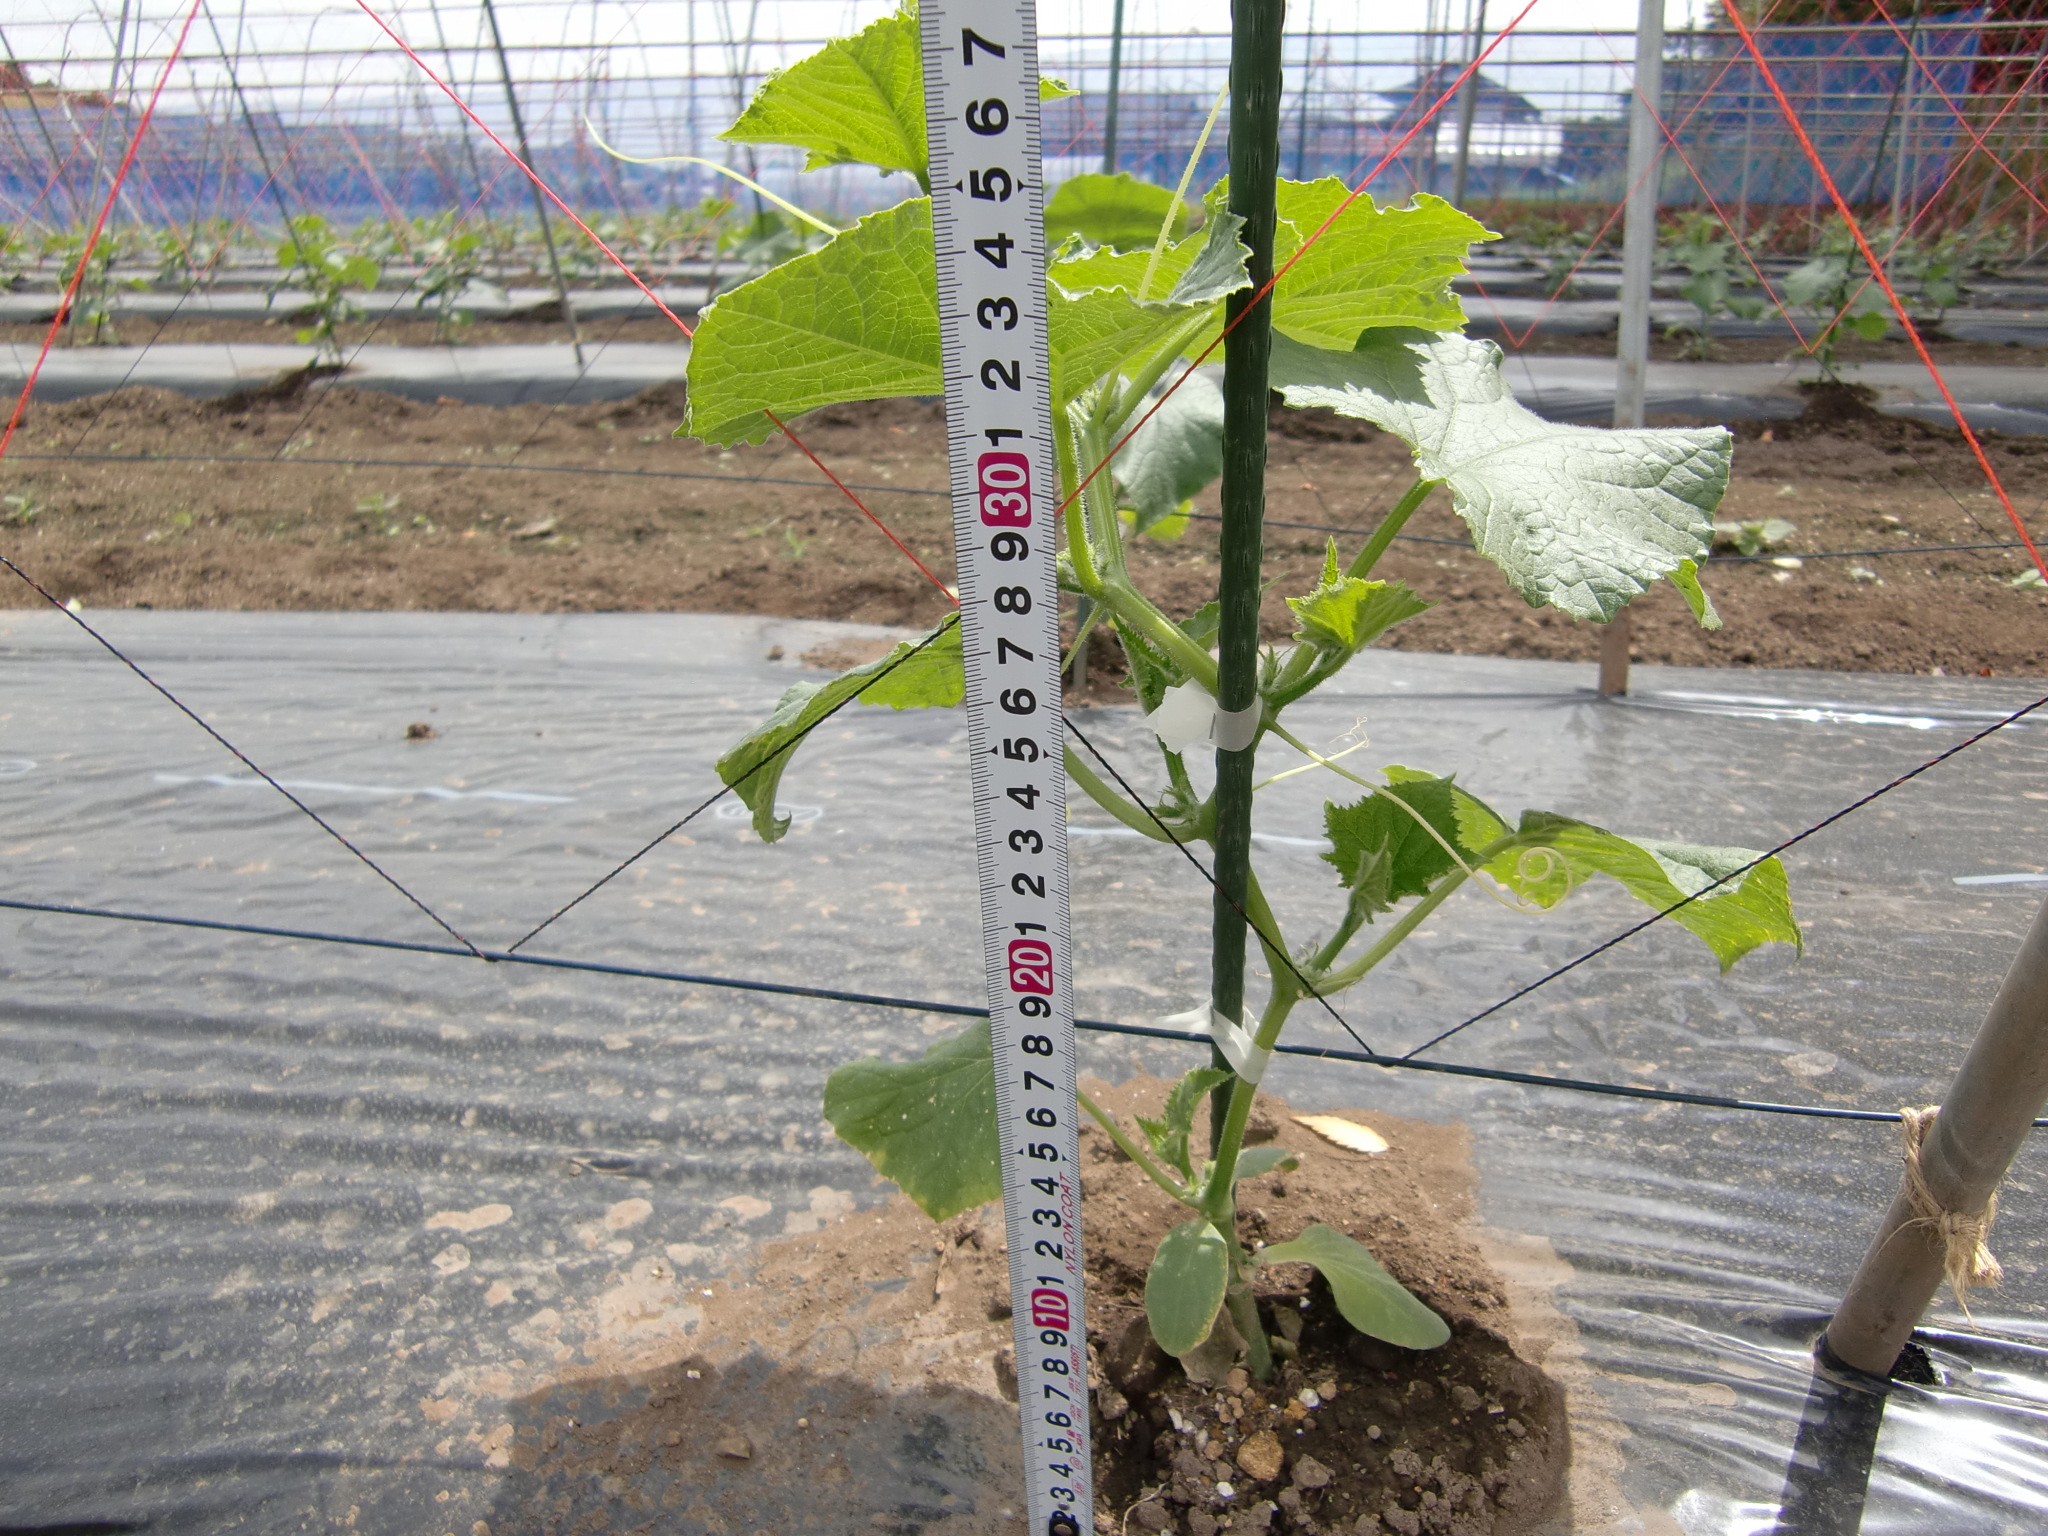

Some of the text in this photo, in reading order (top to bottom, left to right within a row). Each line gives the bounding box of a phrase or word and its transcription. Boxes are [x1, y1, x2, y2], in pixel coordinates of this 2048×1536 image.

[961, 28, 1006, 66] 7
[965, 98, 1009, 136] 6
[969, 167, 1013, 203] 5
[973, 232, 1015, 269] 4
[976, 296, 1019, 331] 3
[980, 359, 1021, 392] 2
[984, 428, 1023, 447] 1
[982, 462, 1028, 517] 30
[990, 531, 1029, 562] 9
[993, 585, 1032, 616] 8
[997, 637, 1034, 665] 7
[999, 688, 1037, 716] 6
[1002, 737, 1039, 763] 5
[1006, 783, 1041, 811] 4
[1008, 829, 1044, 855] 3
[1011, 872, 1046, 899] 2
[1014, 922, 1047, 936] 1
[1011, 946, 1050, 989] 20
[1018, 995, 1052, 1018] 9
[1021, 1034, 1054, 1057] 8
[1023, 1070, 1055, 1091] 7
[1025, 1107, 1057, 1128] 6
[1028, 1142, 1059, 1163] 5
[1030, 1176, 1060, 1196] 4
[1032, 1208, 1062, 1228] 3
[1060, 1173, 1075, 1273] NYLON COAT
[1034, 1239, 1064, 1261] 2
[1036, 1275, 1065, 1286] 1
[1034, 1296, 1067, 1323] 10
[1039, 1329, 1068, 1348] 9
[1041, 1357, 1070, 1376] 8
[1043, 1384, 1070, 1401] 7
[1044, 1411, 1072, 1428] 6
[1046, 1437, 1073, 1454] 5
[1048, 1463, 1074, 1479] 4
[1049, 1486, 1076, 1503] 3
